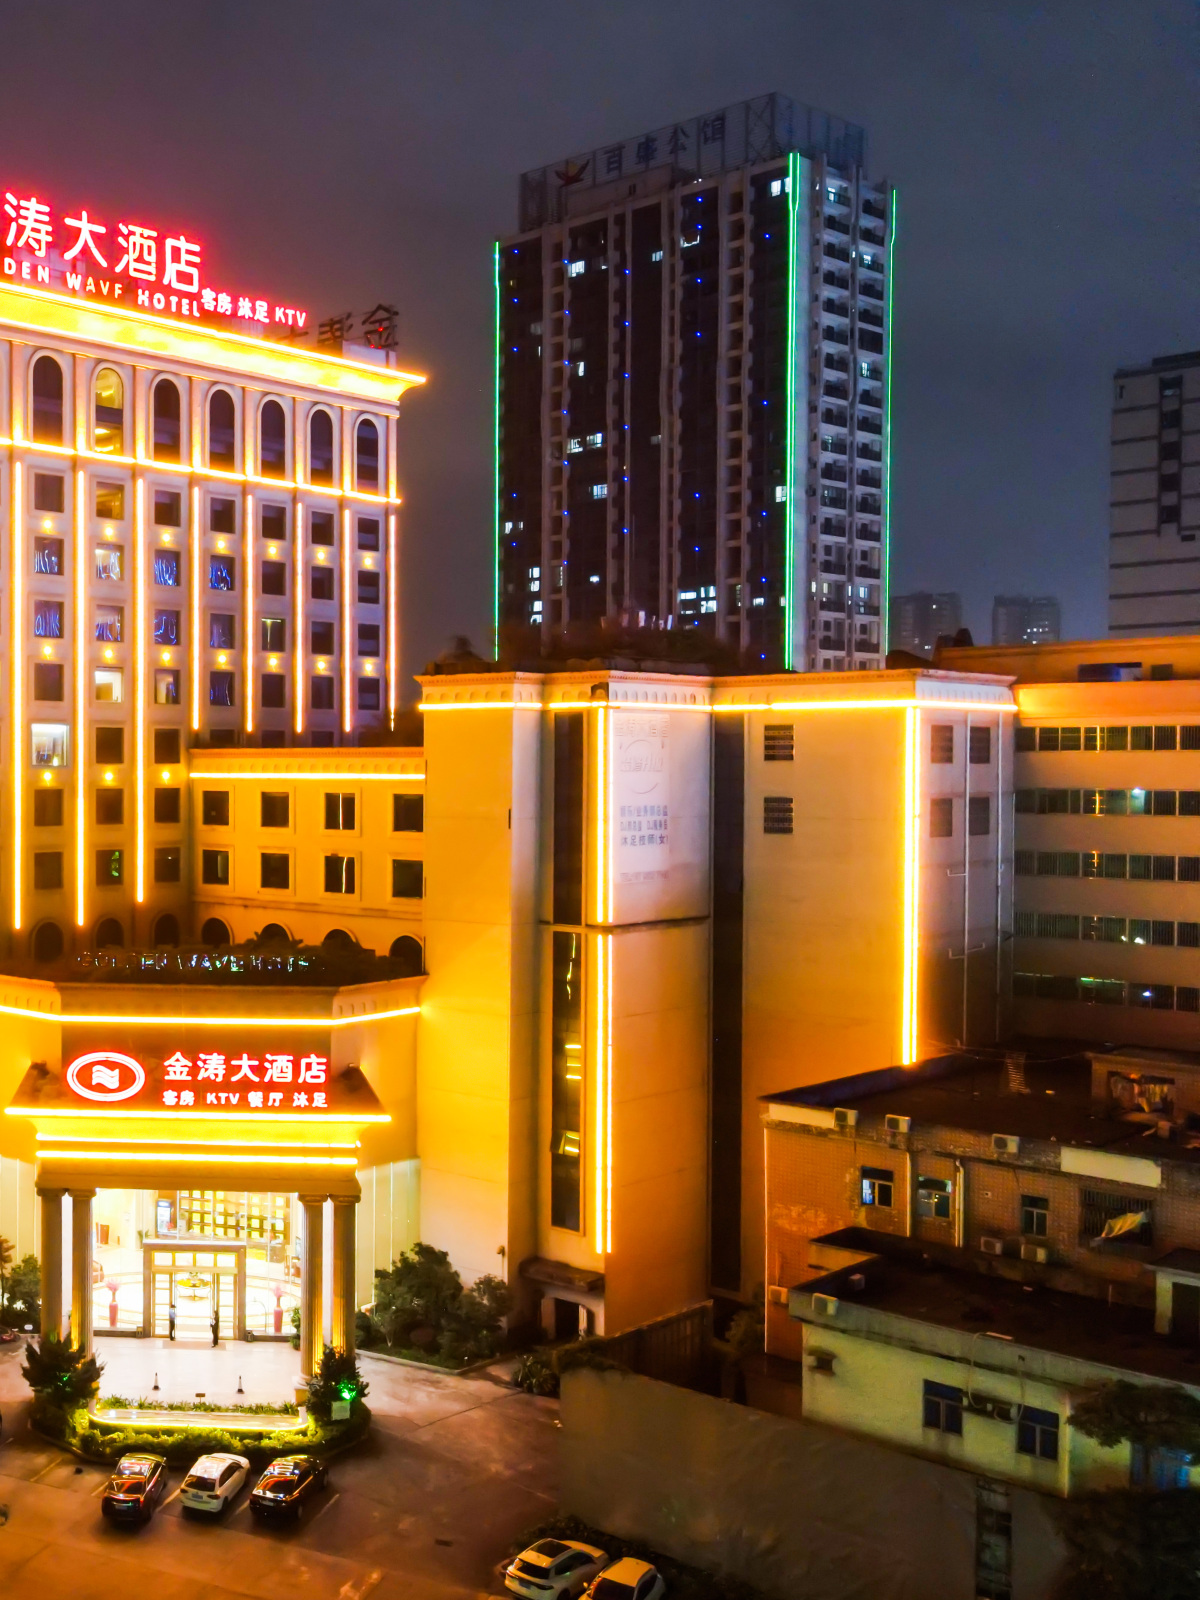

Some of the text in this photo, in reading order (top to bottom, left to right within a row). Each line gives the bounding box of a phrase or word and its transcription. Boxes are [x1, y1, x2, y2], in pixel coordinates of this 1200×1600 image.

[137, 288, 201, 317] HOTEL
[201, 288, 307, 327] 客房 沐足 KTV
[163, 1051, 328, 1083] 金涛大酒店
[162, 1089, 328, 1108] 客房 KTV 餐厅 沐足
